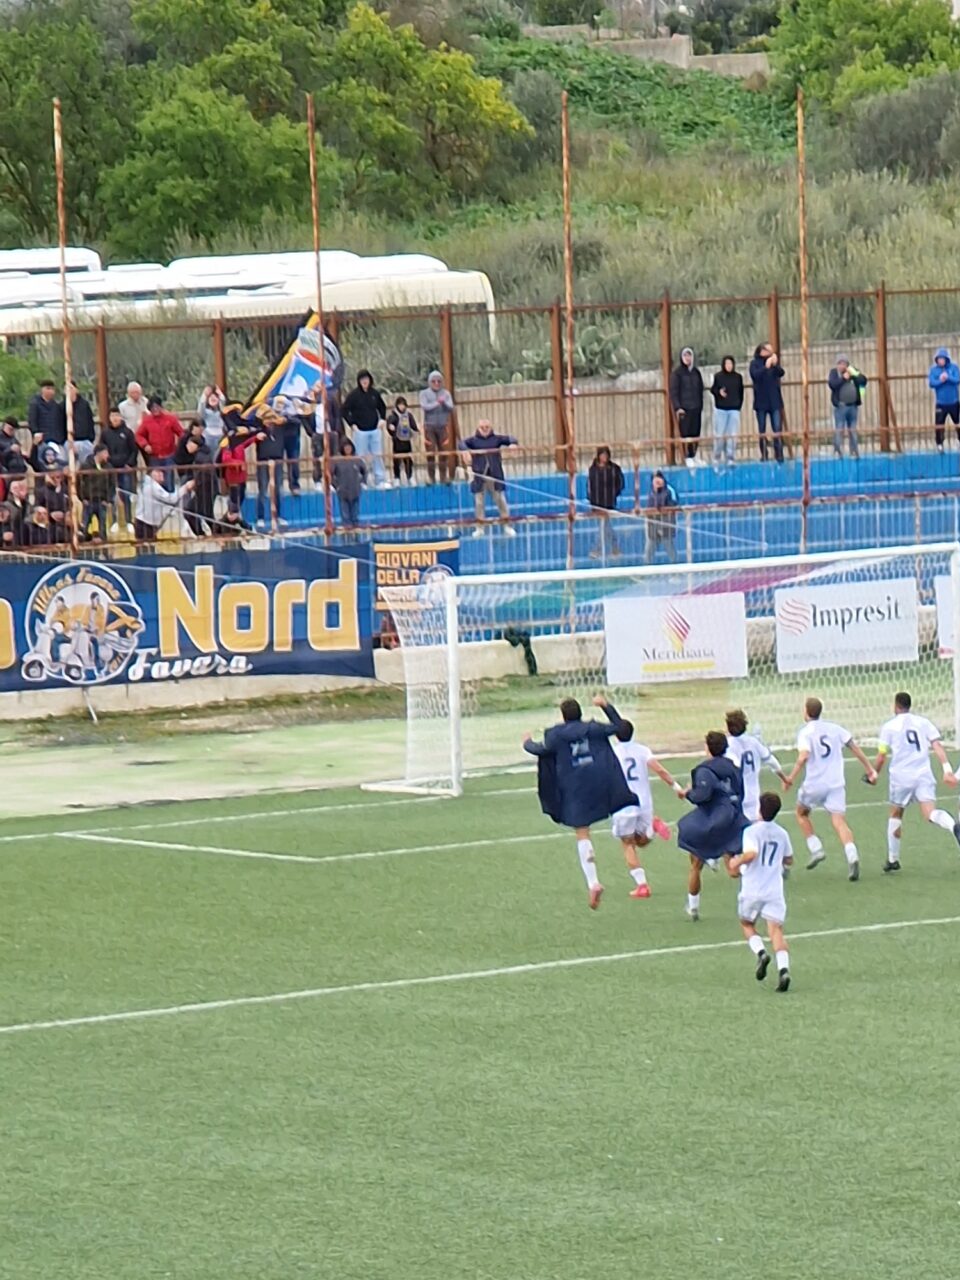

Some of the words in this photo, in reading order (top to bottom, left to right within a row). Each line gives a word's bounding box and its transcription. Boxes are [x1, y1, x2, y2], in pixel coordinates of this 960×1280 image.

[376, 552, 437, 567] GIOVANI
[376, 569, 420, 585] DELLA
[156, 558, 361, 658] Nord
[811, 595, 902, 633] Impresit
[819, 734, 832, 759] 5
[906, 730, 921, 752] 9
[626, 757, 639, 781] 2
[761, 840, 779, 866] 17
